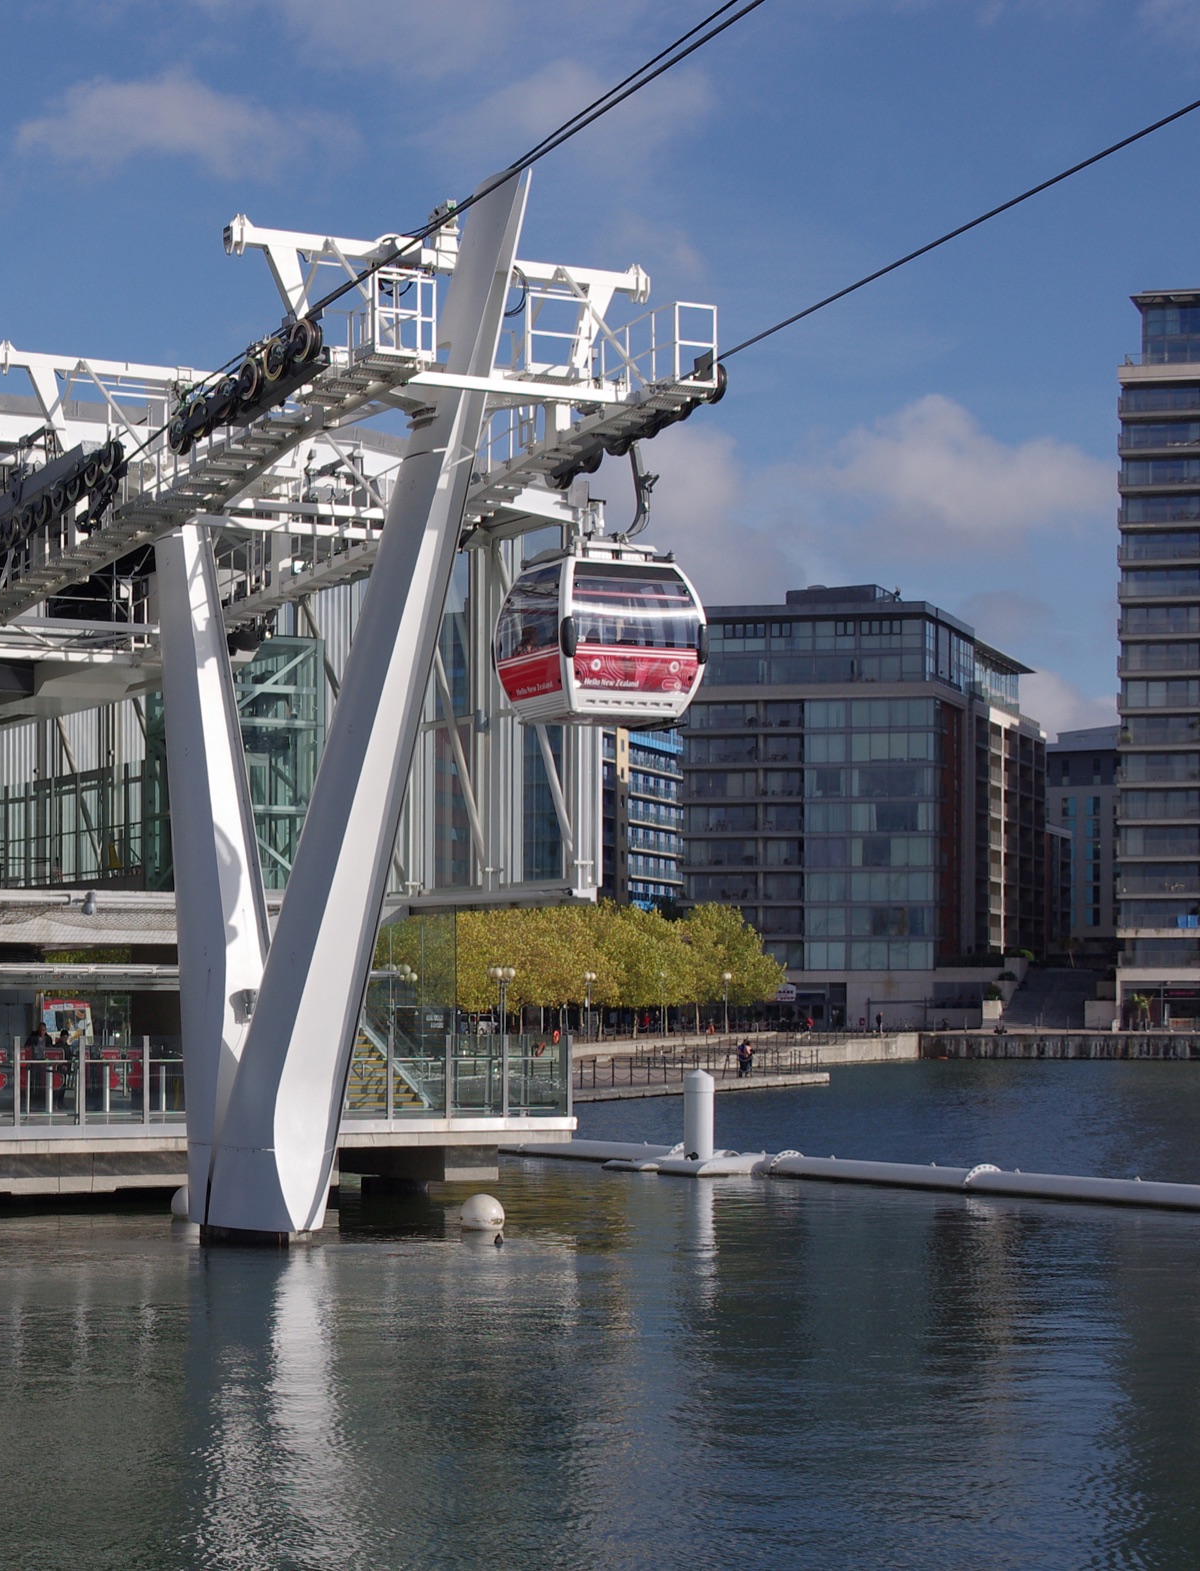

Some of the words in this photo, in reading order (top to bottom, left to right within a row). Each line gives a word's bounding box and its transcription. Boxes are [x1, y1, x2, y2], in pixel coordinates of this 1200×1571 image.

[584, 677, 600, 686] Hello
[600, 678, 615, 687] New
[615, 678, 639, 688] Zealand
